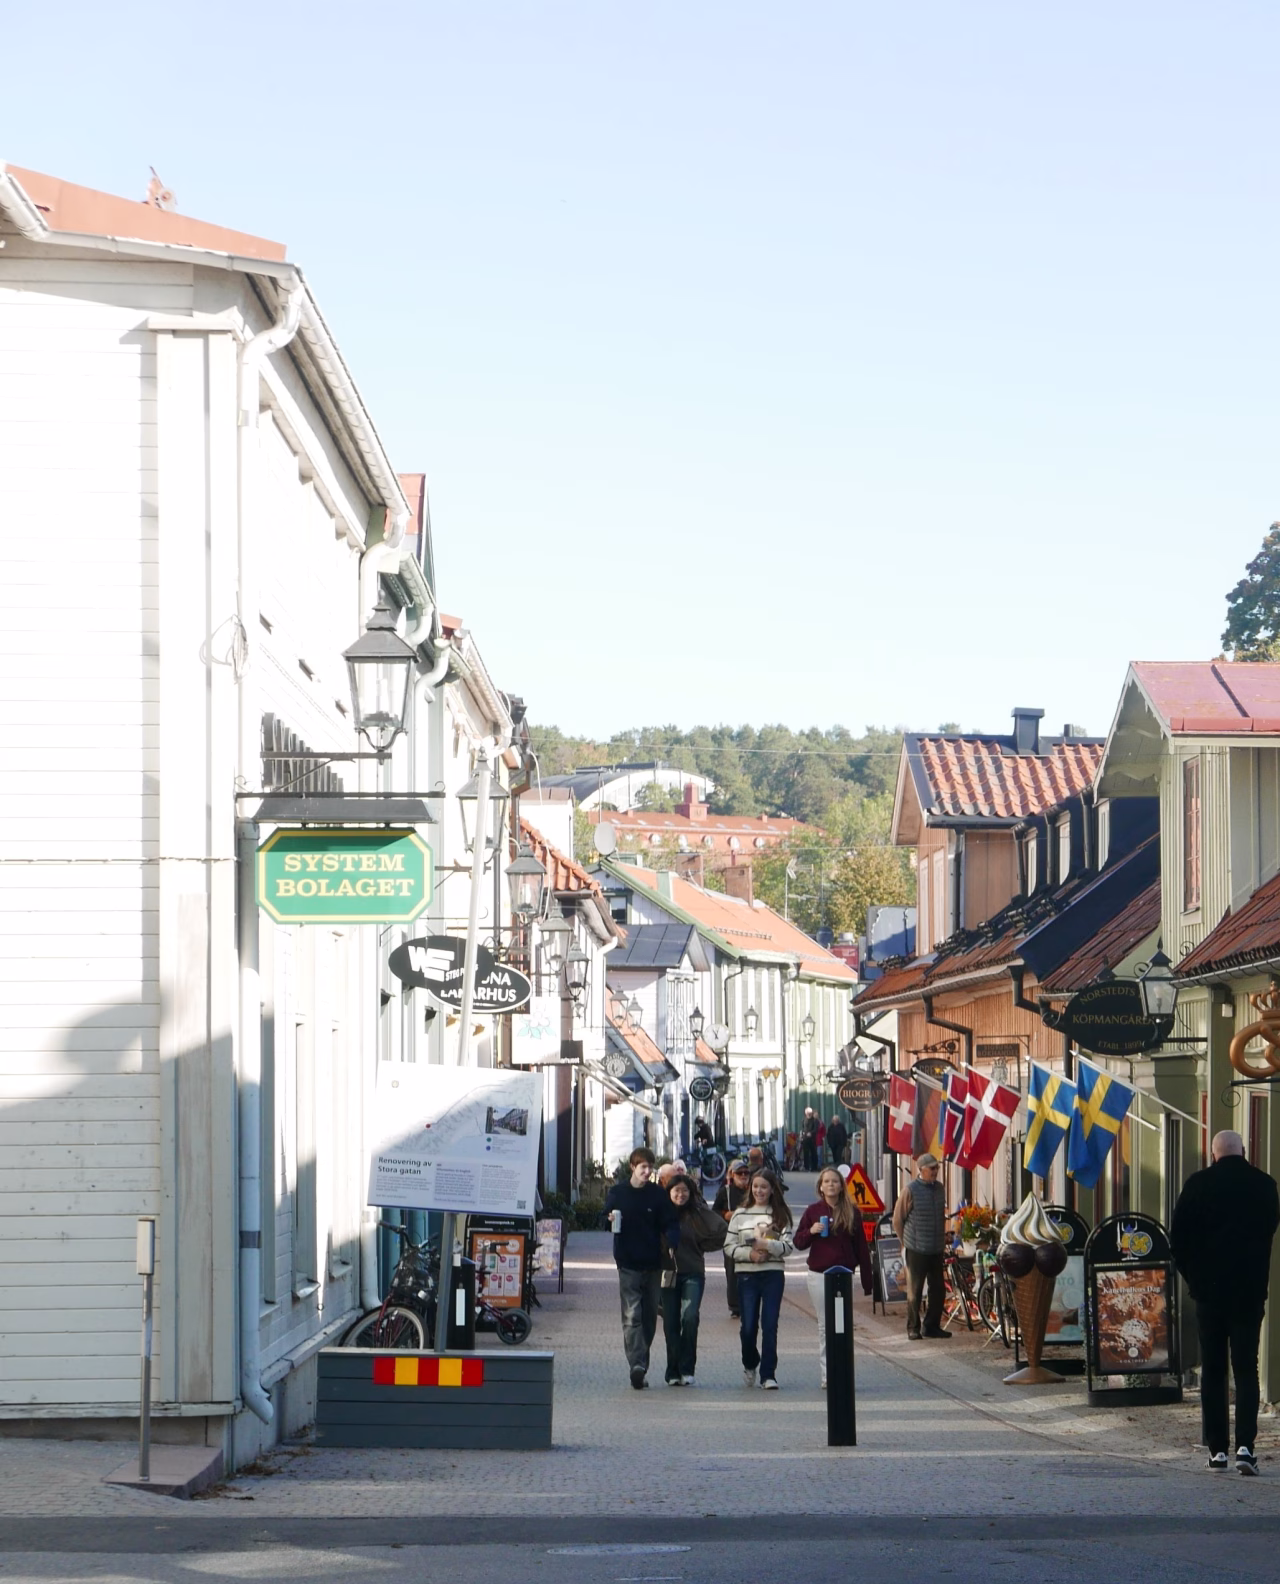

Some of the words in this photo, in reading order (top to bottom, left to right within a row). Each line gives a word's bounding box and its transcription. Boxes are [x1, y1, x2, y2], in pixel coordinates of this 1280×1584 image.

[284, 853, 405, 873] SYSTEM
[276, 878, 415, 897] BOLAGET
[1080, 987, 1136, 1004] NORSTEDTS
[1072, 1013, 1167, 1025] KÖPMANGÅRD
[842, 1089, 883, 1098] BIOGRAF
[378, 1157, 421, 1168] Renovering
[377, 1165, 398, 1174] Stora
[399, 1167, 422, 1176] gatan
[1147, 1286, 1161, 1294] Dag
